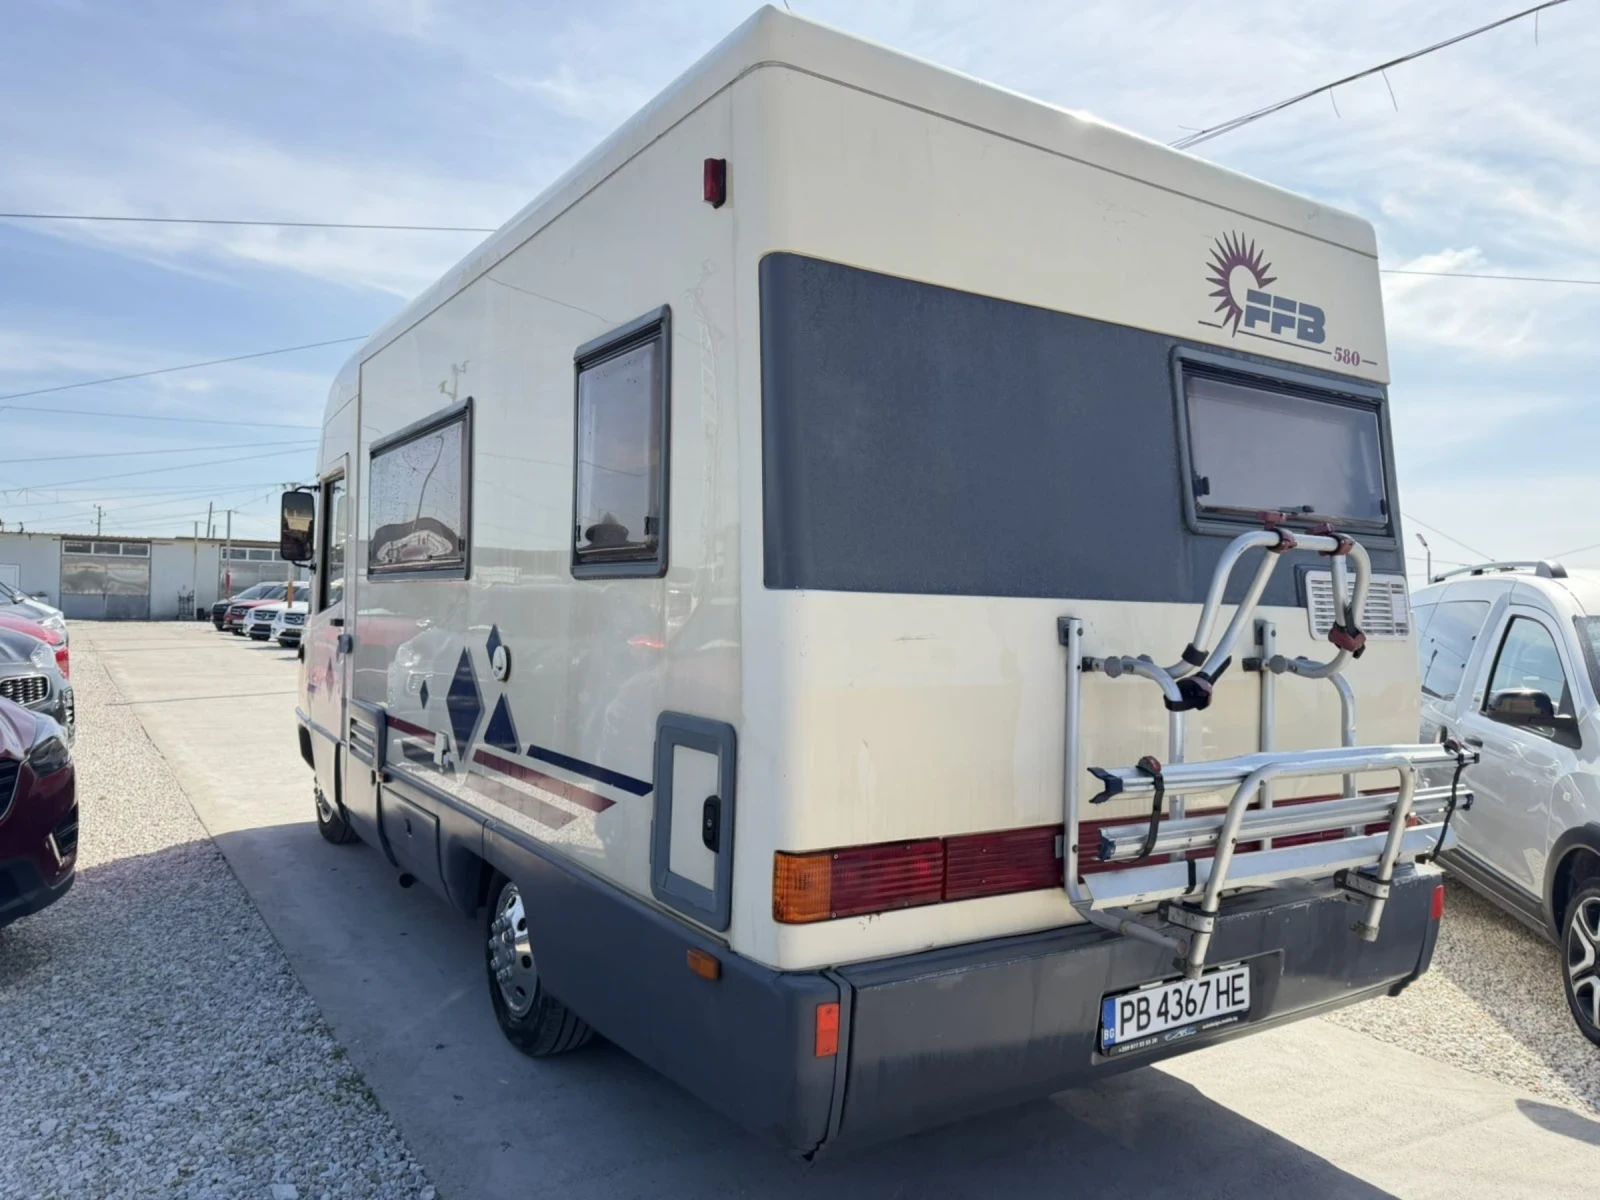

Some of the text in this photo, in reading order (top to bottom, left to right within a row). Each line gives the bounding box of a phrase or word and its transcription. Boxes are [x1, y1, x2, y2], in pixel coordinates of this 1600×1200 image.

[1244, 288, 1326, 344] FFB
[1333, 347, 1360, 367] 580
[1120, 973, 1245, 1036] PB 4367 HE
[1104, 1028, 1115, 1041] BG
